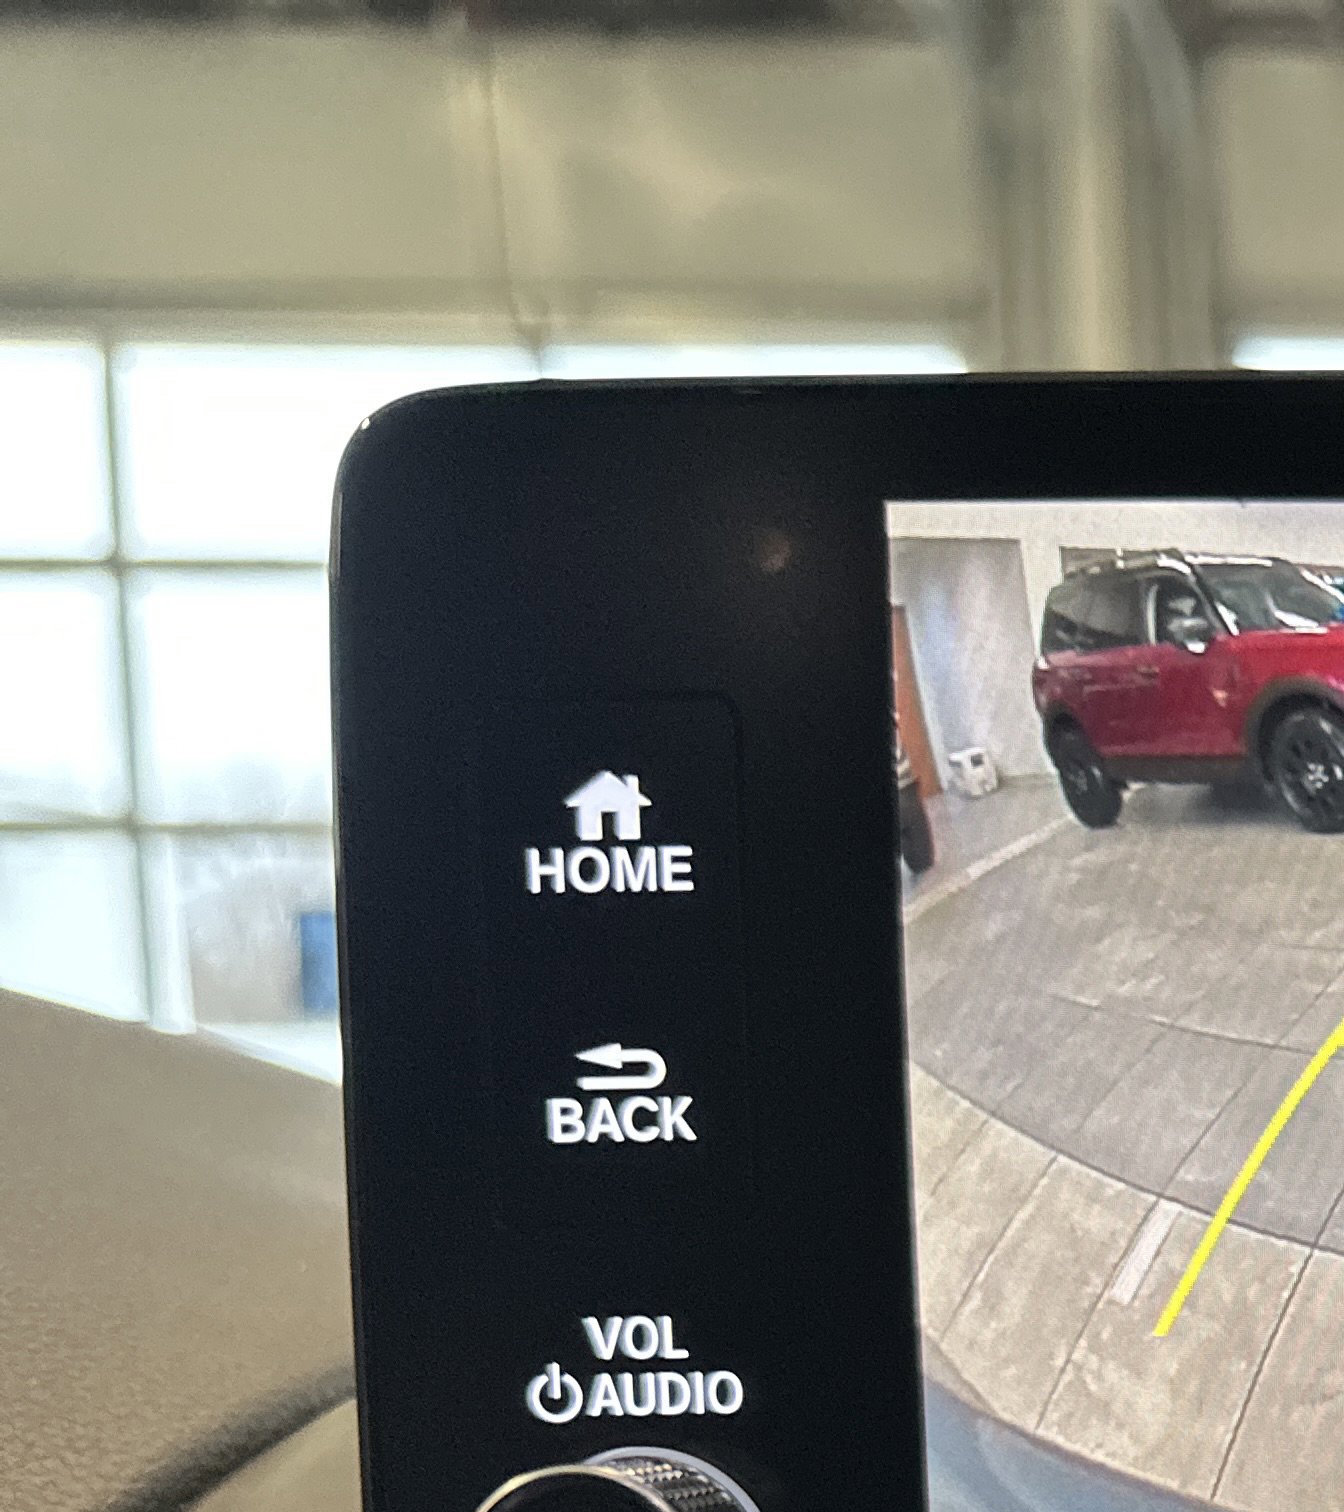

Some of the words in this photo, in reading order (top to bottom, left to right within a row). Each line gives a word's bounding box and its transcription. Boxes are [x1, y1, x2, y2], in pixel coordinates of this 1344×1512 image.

[526, 845, 694, 894] HOME
[546, 1096, 697, 1143] BACK
[582, 1316, 689, 1360] VOL
[585, 1371, 743, 1416] AUDIO
